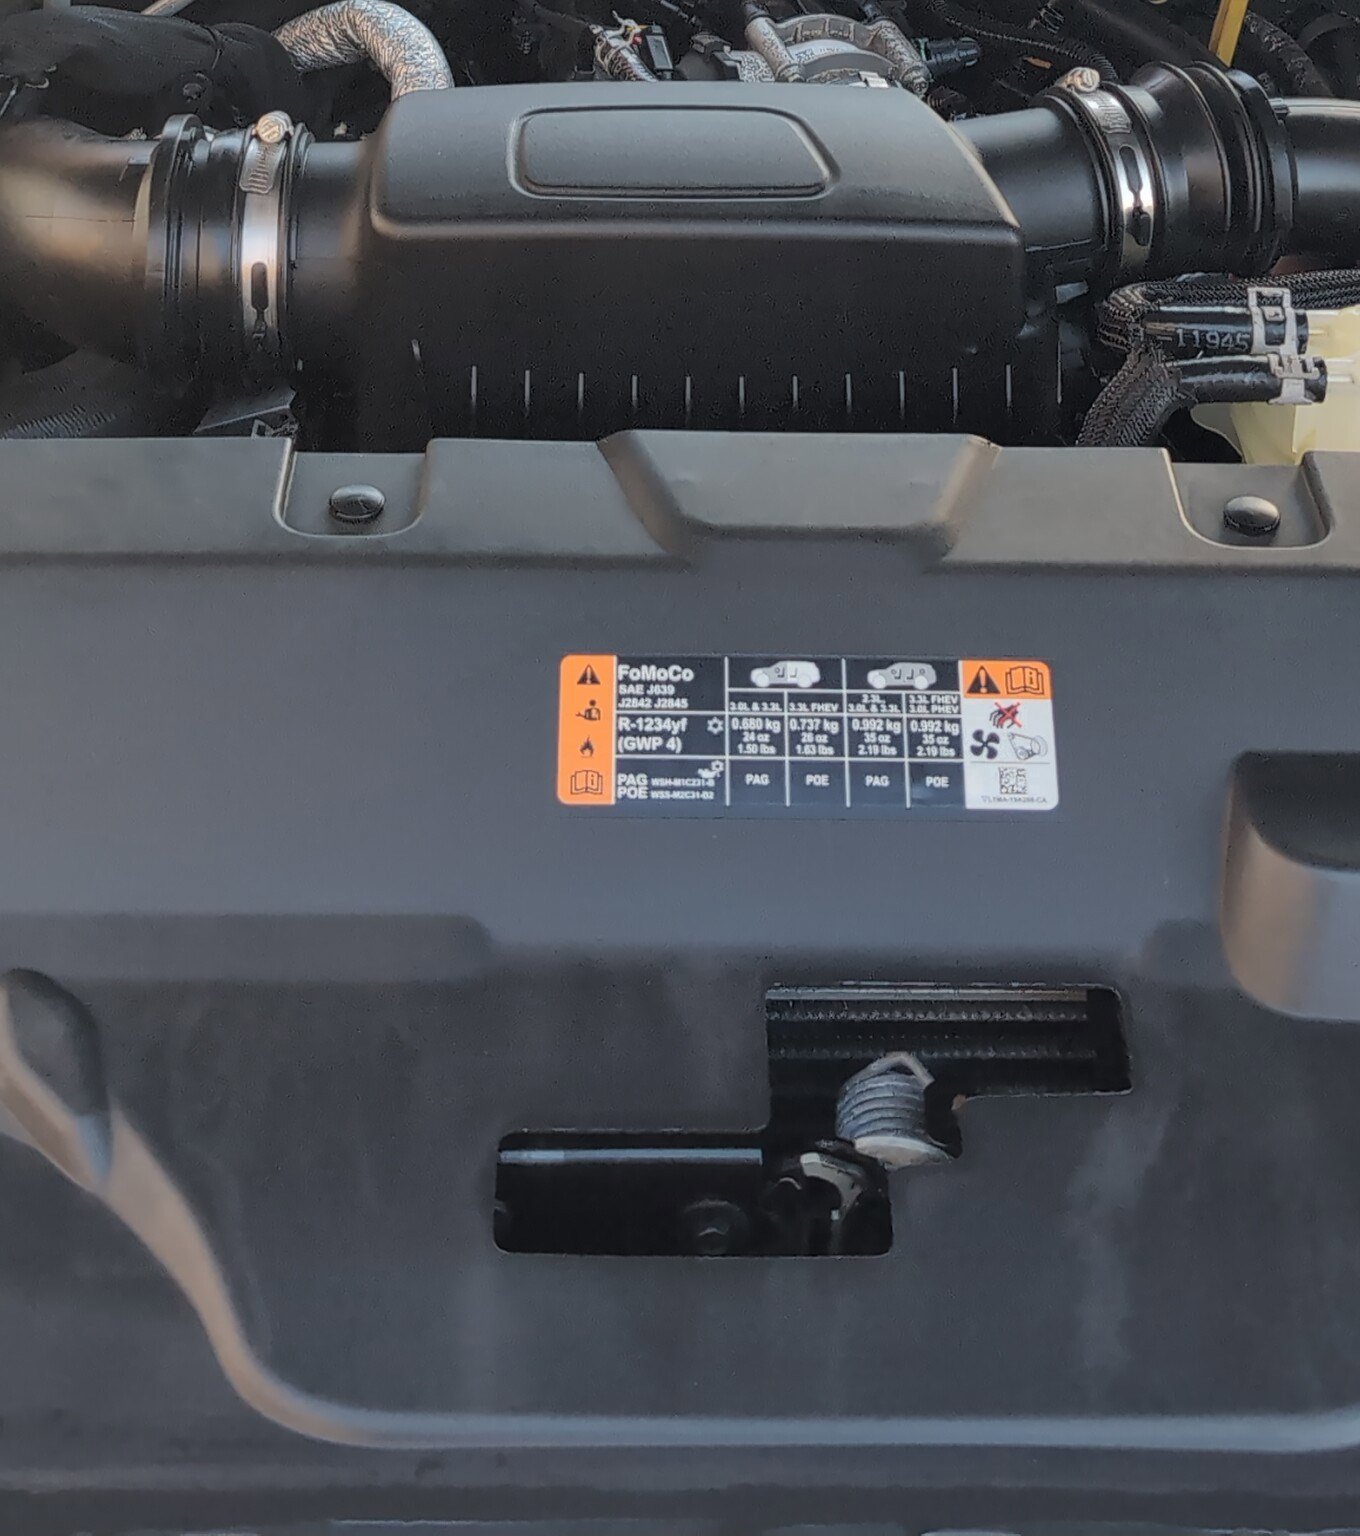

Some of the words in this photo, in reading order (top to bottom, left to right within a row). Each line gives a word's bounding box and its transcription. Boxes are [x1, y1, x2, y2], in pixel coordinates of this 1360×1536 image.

[617, 664, 694, 682] FoMoCo
[619, 684, 644, 695] SAE
[646, 684, 676, 695] J639
[618, 697, 653, 708] J2842
[654, 697, 688, 708] J2845
[909, 695, 929, 704] 3.3L
[931, 695, 959, 704] FHEV
[752, 702, 760, 712] &
[811, 703, 839, 712] FHEV
[848, 703, 869, 712] 3.0L
[870, 704, 878, 713] &
[880, 704, 901, 713] 3.3L
[931, 705, 959, 714] PHEV
[618, 717, 688, 735] R-1234yf
[731, 717, 763, 730] 0.680
[765, 718, 781, 733] kg
[789, 718, 821, 731] 0.737
[823, 718, 839, 734] kg
[852, 719, 884, 731] 0.992
[886, 719, 901, 734] kg
[910, 720, 942, 732] 0.992
[944, 720, 960, 736] kg
[743, 732, 756, 742] 24
[757, 733, 770, 742] oz
[801, 732, 814, 743] 26
[815, 734, 828, 743] oz
[864, 732, 877, 743] 35
[878, 734, 891, 743] oz
[922, 734, 935, 745] 35
[936, 736, 949, 745] oz
[618, 736, 663, 754] (GWP
[665, 736, 683, 754] 4)
[737, 743, 758, 754] 1.50
[760, 744, 777, 754] lbs
[795, 744, 817, 755] 1.63
[818, 744, 835, 755] lbs
[858, 744, 879, 755] 2.19
[881, 744, 897, 755] lbs
[917, 746, 938, 757] 2.19
[939, 746, 956, 757] lbs
[617, 773, 648, 786] PAG
[745, 773, 771, 786] PAG
[805, 774, 830, 786] POE
[865, 775, 890, 787] PAG
[926, 776, 950, 788] POE
[617, 786, 648, 799] POE
